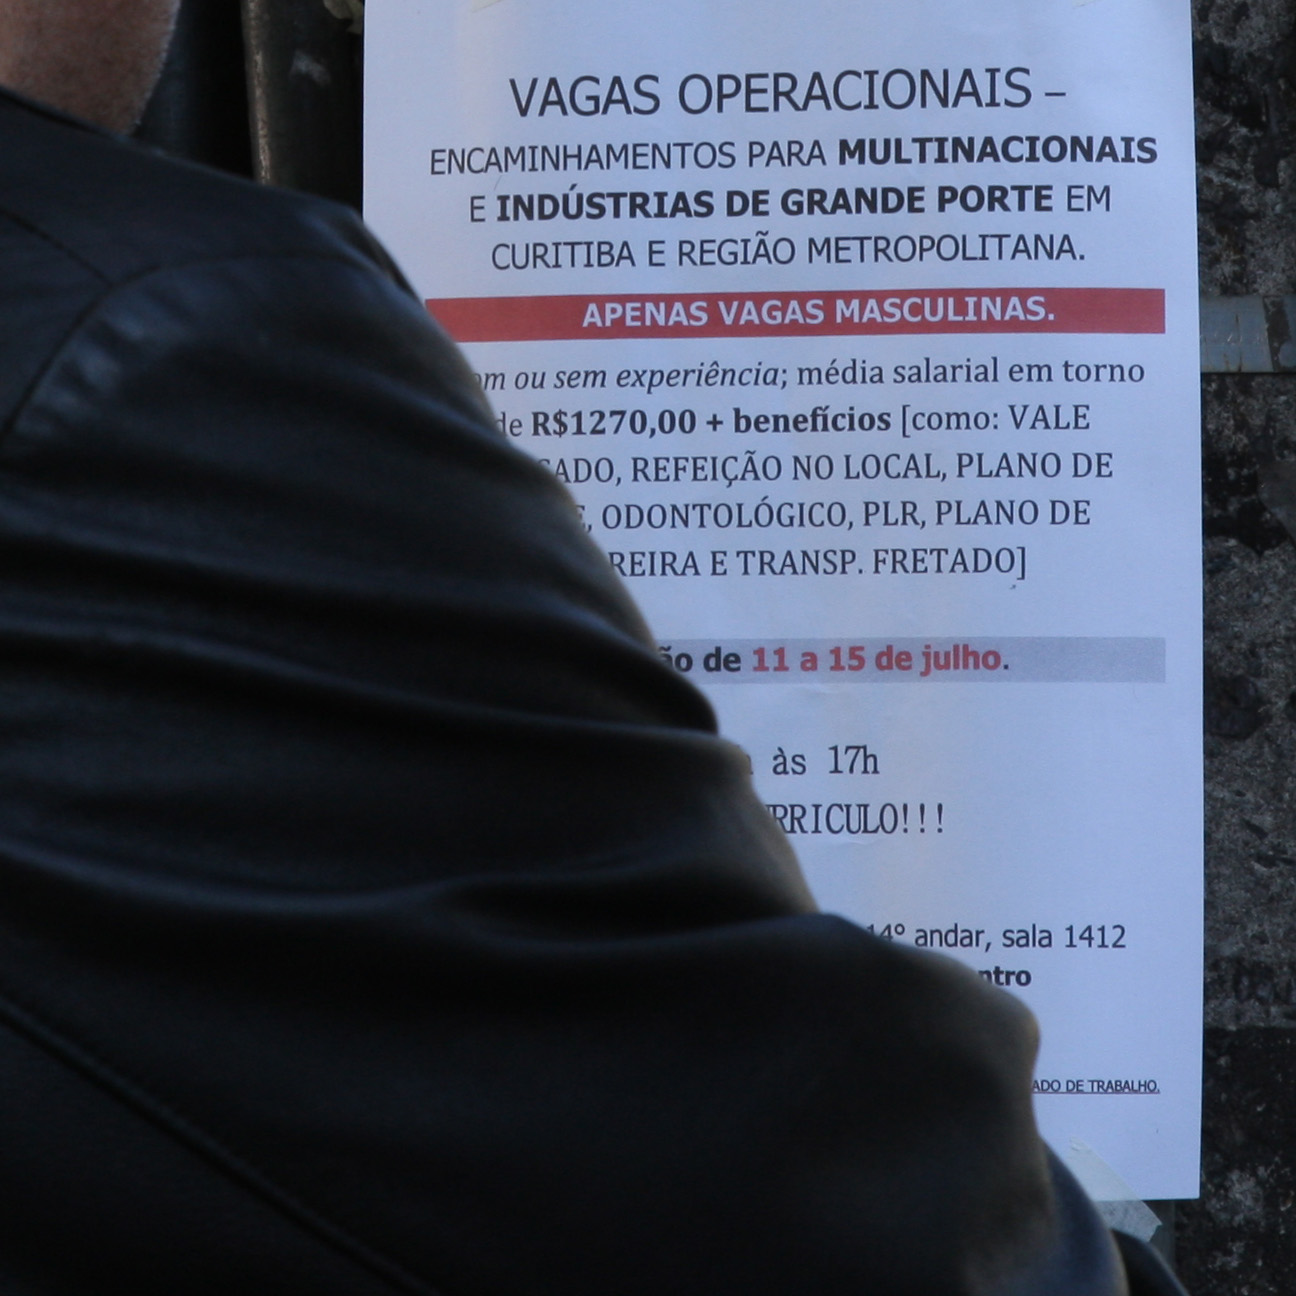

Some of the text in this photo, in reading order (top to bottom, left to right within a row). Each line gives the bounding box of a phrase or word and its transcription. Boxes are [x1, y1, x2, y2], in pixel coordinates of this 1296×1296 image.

[509, 74, 661, 118] VAGAS
[678, 66, 1032, 115] OPERACIONAIS
[430, 134, 1158, 176] ENCAMINHAMENTOS PARA MULTINACIONAIS
[470, 183, 1111, 223] E INDÚSTRIAS DE GRANDE PORTE EM
[491, 230, 1085, 271] CURITIBA E REGIÃO METROPOLITANA.
[583, 295, 1056, 328] APENAS VAGAS MASCULINAS.
[514, 371, 546, 390] ou
[553, 369, 607, 389] sem
[616, 360, 787, 395] experiência;
[797, 358, 885, 386] média
[893, 356, 999, 384] salarial
[1008, 363, 1054, 383] em
[1062, 360, 1145, 383] torno
[531, 408, 697, 439] R$1270,00
[706, 413, 724, 432] +
[732, 405, 891, 434] benefícios
[901, 404, 998, 439] [como:
[1008, 404, 1090, 430] VALE
[538, 449, 1113, 489] ADO, REFEIÇÃO NO LOCAL, PLANO DE
[602, 495, 854, 531] ODONTOLÓGICO,
[863, 500, 926, 530] PLR,
[935, 499, 1039, 526] PLANO
[1049, 499, 1091, 525] DE
[710, 550, 728, 576] E
[735, 549, 863, 576] TRANSP.
[873, 546, 1026, 581] FRETADO]
[703, 647, 741, 672] de
[753, 648, 789, 671] 11
[800, 650, 818, 672] a
[829, 646, 866, 671] 15
[875, 645, 913, 670] de
[919, 644, 1009, 677] julho.
[772, 746, 807, 776] às
[828, 744, 880, 775] 17h
[766, 803, 943, 834] RRICULO!!!
[914, 923, 991, 953] andar,
[1002, 923, 1053, 949] sala
[1065, 924, 1126, 949] 1412
[1066, 1080, 1084, 1092] DE
[1089, 1080, 1160, 1092] TRABALHO.
